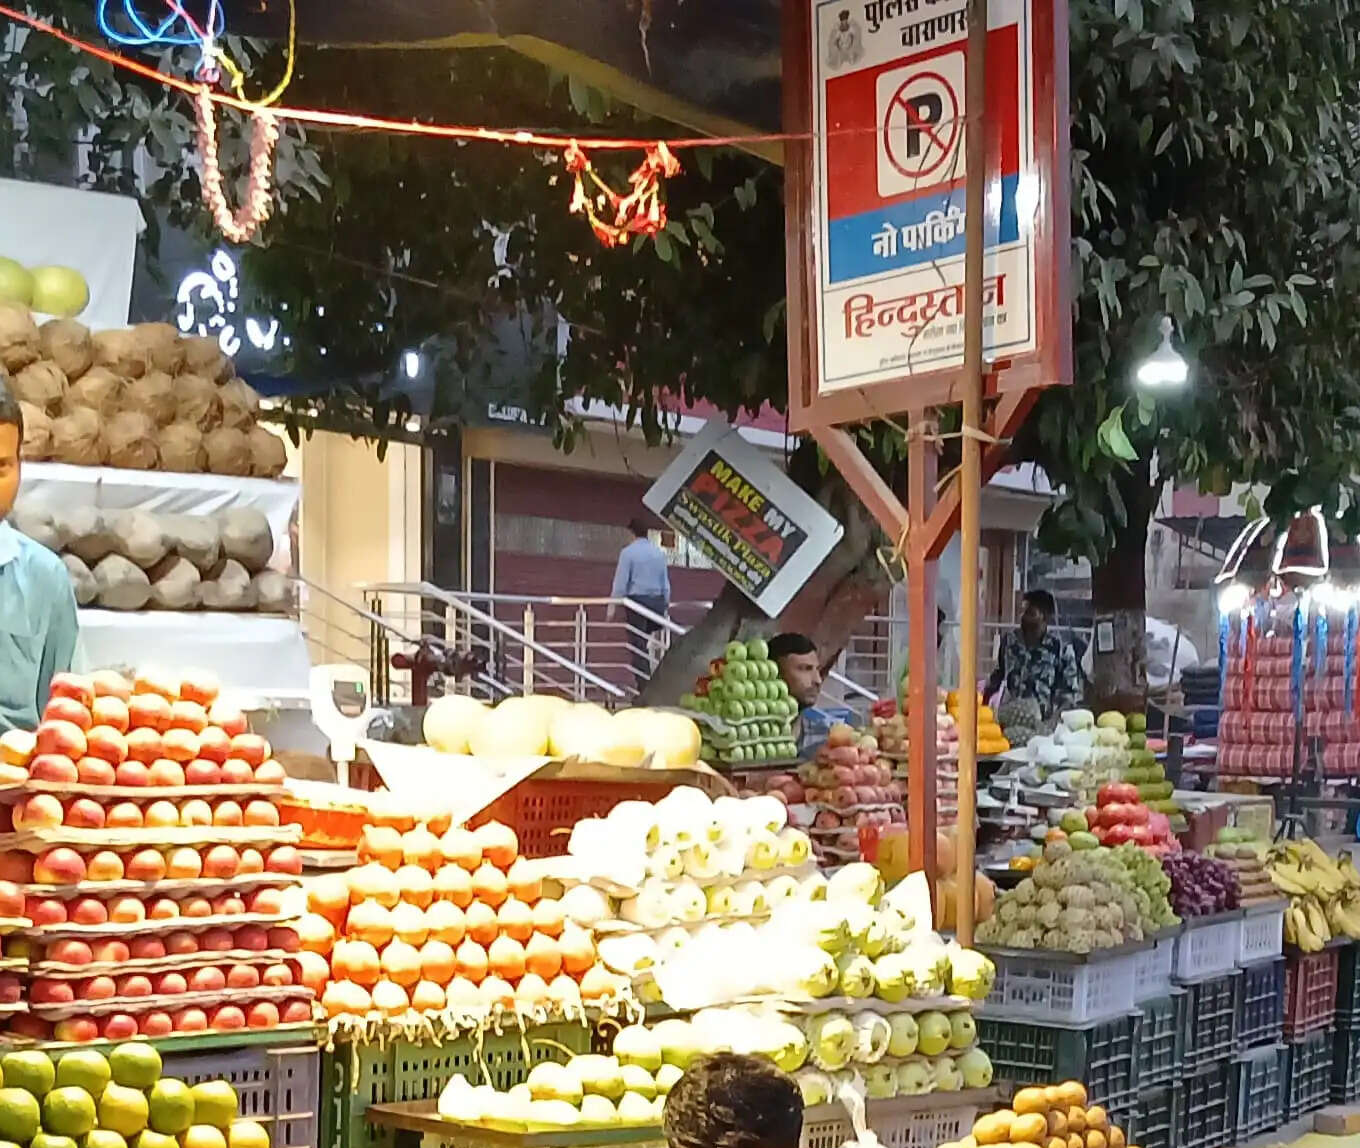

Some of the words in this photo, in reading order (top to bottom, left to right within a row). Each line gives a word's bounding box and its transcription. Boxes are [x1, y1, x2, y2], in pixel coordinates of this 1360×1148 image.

[871, 220, 898, 259] नो
[842, 273, 1007, 339] हिन्दुस्तन
[691, 471, 785, 565] PIZZA
[710, 460, 764, 512] MAKE
[763, 508, 796, 539] MY
[734, 541, 773, 578] Plaza
